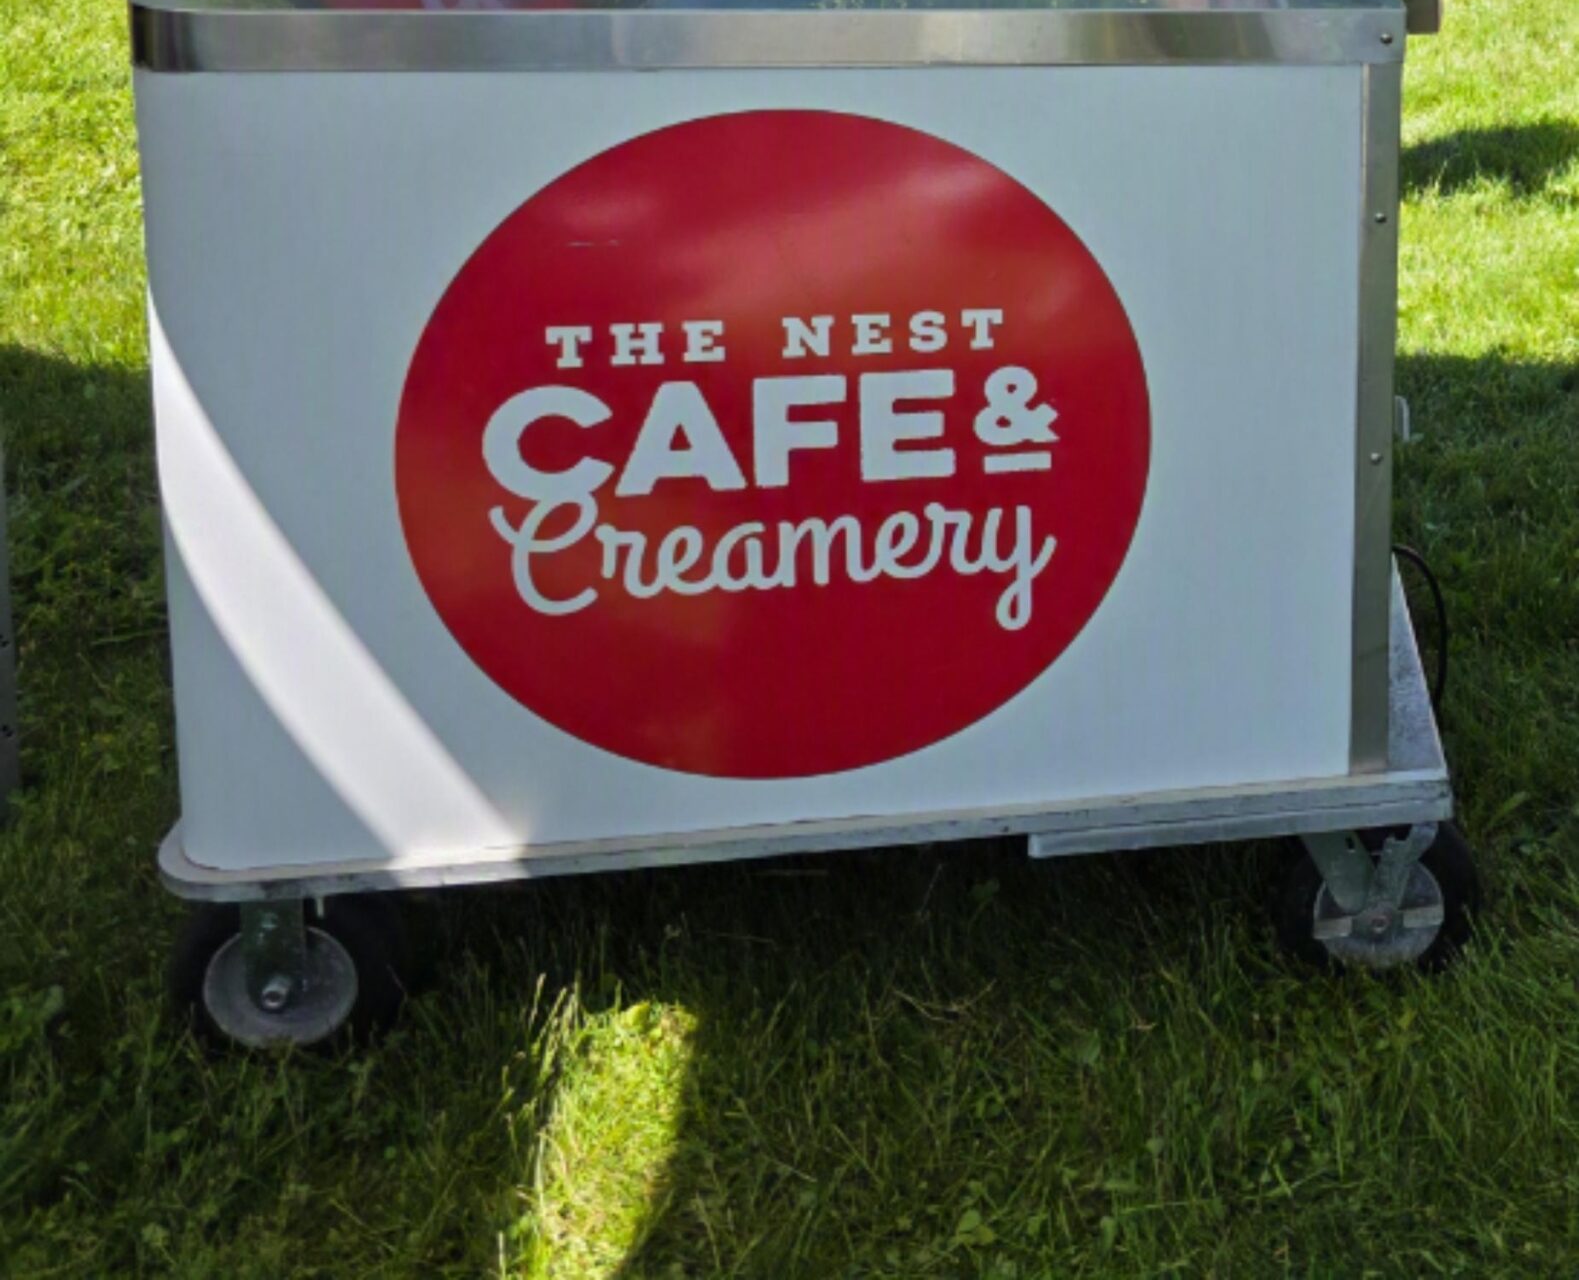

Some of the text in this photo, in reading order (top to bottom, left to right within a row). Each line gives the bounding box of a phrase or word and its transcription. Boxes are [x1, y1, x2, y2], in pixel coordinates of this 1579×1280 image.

[545, 308, 1004, 369] THE NEST
[481, 365, 1060, 501] CAFE &
[488, 494, 1058, 631] Creamery
